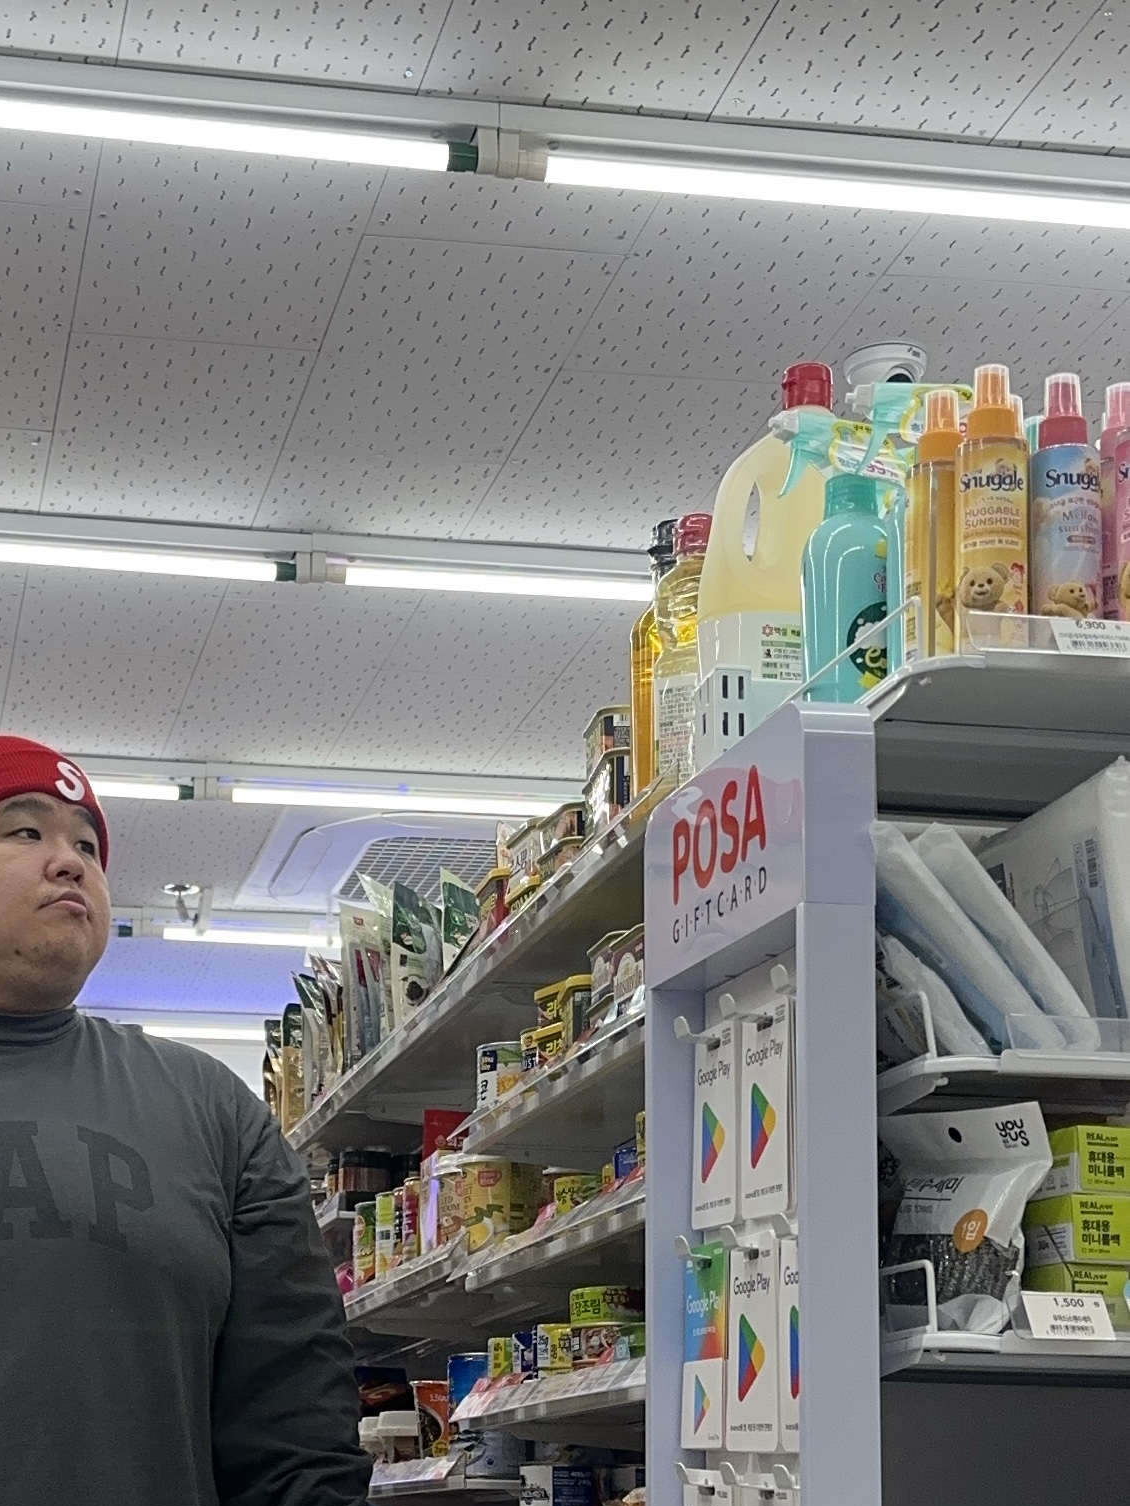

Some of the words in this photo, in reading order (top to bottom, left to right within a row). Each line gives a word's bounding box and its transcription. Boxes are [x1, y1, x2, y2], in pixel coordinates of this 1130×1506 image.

[959, 463, 1024, 494] Snuggle
[964, 505, 1021, 520] HUGGABLE
[963, 517, 1021, 531] SUNSHINE
[55, 760, 86, 801] S
[672, 764, 767, 906] POSA
[745, 1044, 769, 1068] Google
[769, 1038, 784, 1060] Play
[698, 1064, 717, 1087] Google
[718, 1060, 731, 1080] Play
[1086, 1131, 1105, 1141] REAL
[1087, 1150, 1116, 1165] 휴대용
[1079, 1201, 1100, 1211] REAL
[1081, 1219, 1111, 1234] 휴대용
[784, 1265, 800, 1287] Goo
[1073, 1270, 1094, 1281] REAL
[733, 1274, 756, 1299] Google
[756, 1272, 771, 1295] Play
[686, 1291, 709, 1319] Google
[1053, 1297, 1085, 1308] 1,500
